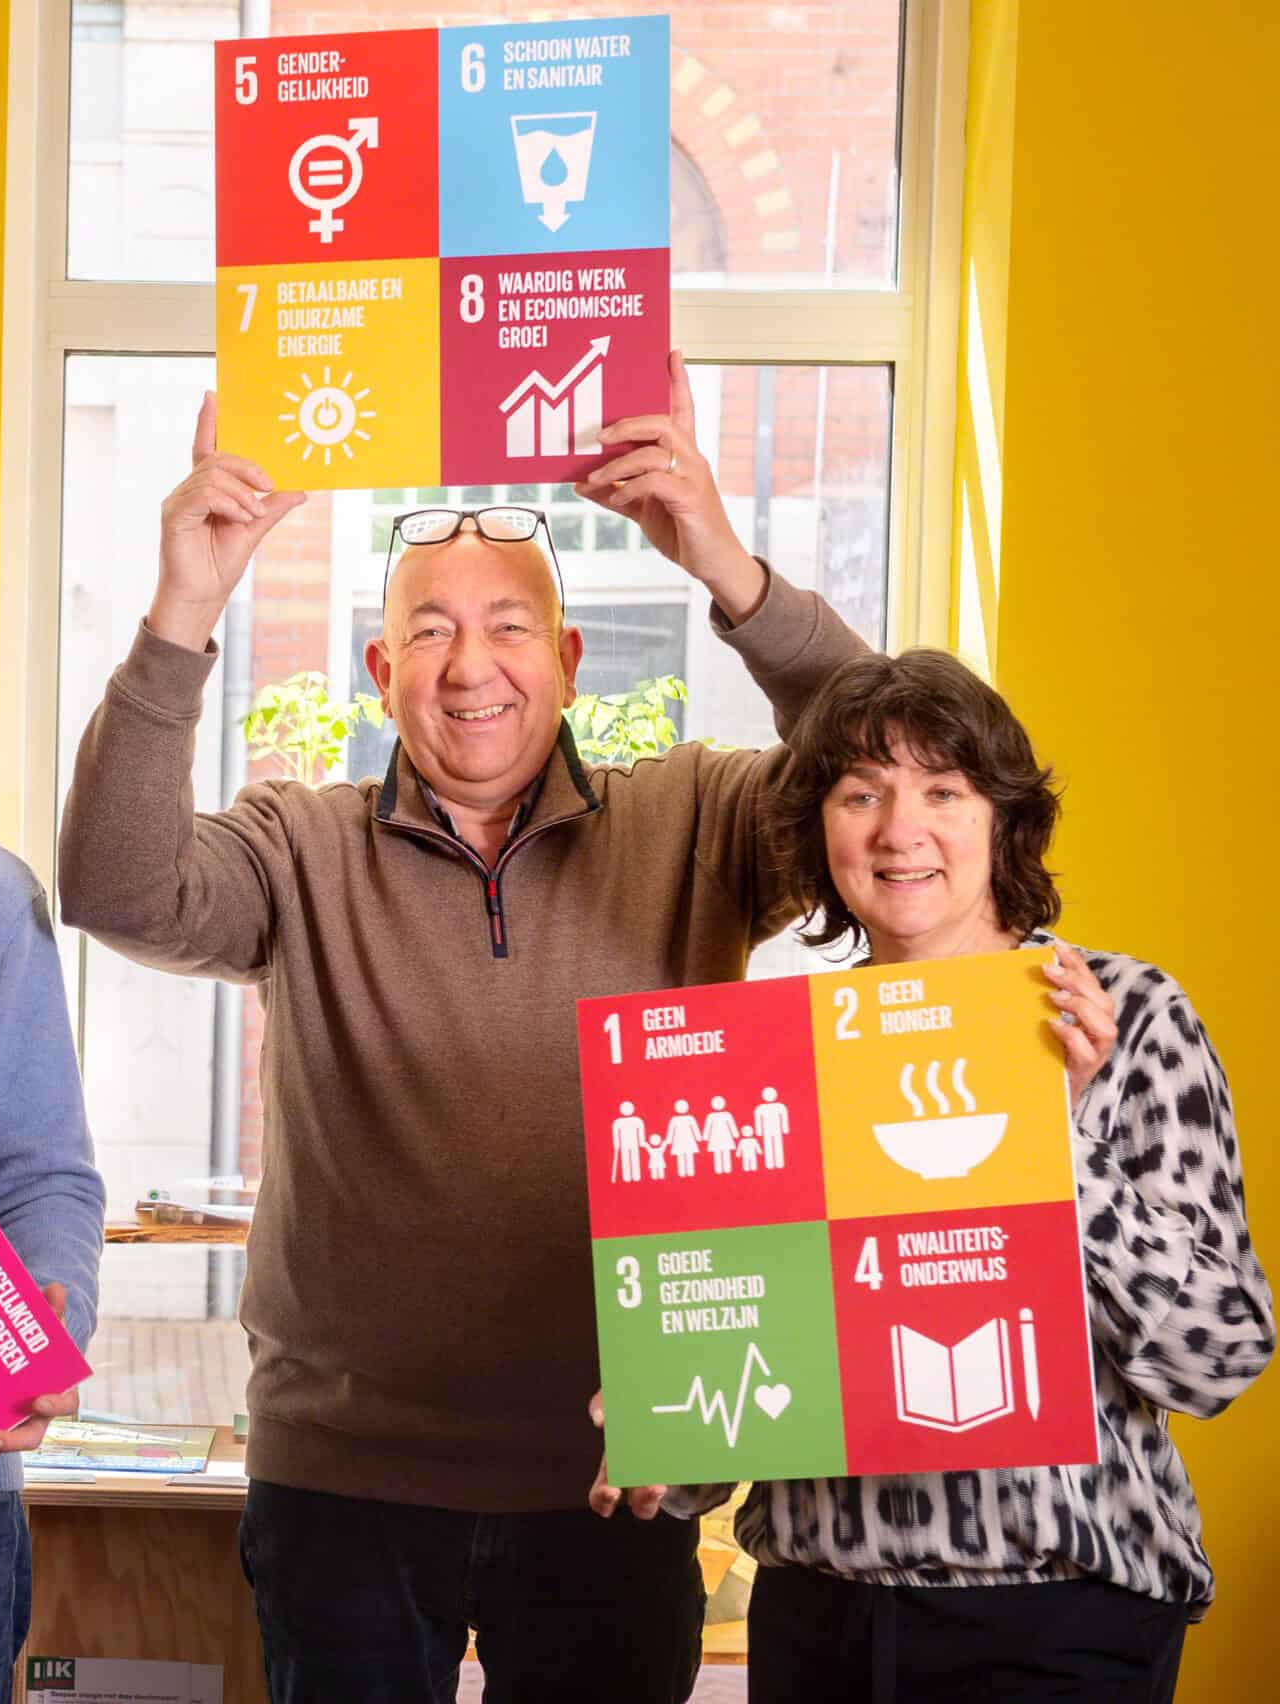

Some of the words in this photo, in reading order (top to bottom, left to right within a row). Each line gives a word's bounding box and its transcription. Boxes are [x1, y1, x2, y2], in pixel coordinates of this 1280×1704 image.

[278, 51, 346, 75] GENDER-
[503, 37, 572, 64] SCHOON
[574, 34, 631, 59] WATER
[235, 56, 258, 105] 5
[461, 42, 486, 93] 6
[503, 68, 524, 91] EN
[527, 64, 603, 89] SANITAIR
[278, 76, 369, 102] GELIJKHEID
[277, 278, 379, 305] BETAALBARE
[381, 277, 402, 299] EN
[498, 270, 573, 295] WAARDIG
[577, 267, 626, 292] WERK
[236, 283, 258, 333] 7
[459, 273, 485, 324] 8
[498, 299, 520, 322] EN
[525, 294, 644, 321] ECONOMISCHE
[277, 306, 365, 331] DUURZAME
[277, 334, 343, 358] ENERGIE
[498, 325, 548, 349] GROEI
[878, 979, 924, 1006] GEEN
[642, 1005, 686, 1032] GEEN
[833, 986, 861, 1041] 2
[880, 1005, 953, 1035] HONGER
[604, 1013, 622, 1065] 1
[645, 1030, 726, 1060] ARMOEDE
[897, 1226, 1009, 1258] KWALITEITS-
[658, 1249, 713, 1276] GOEDE
[854, 1236, 883, 1290] 4
[900, 1256, 1008, 1288] ONDERWIJS
[616, 1256, 642, 1309] 3
[660, 1275, 765, 1305] GEZONDHEID
[661, 1311, 684, 1334] EN
[685, 1305, 760, 1332] WELZIJN
